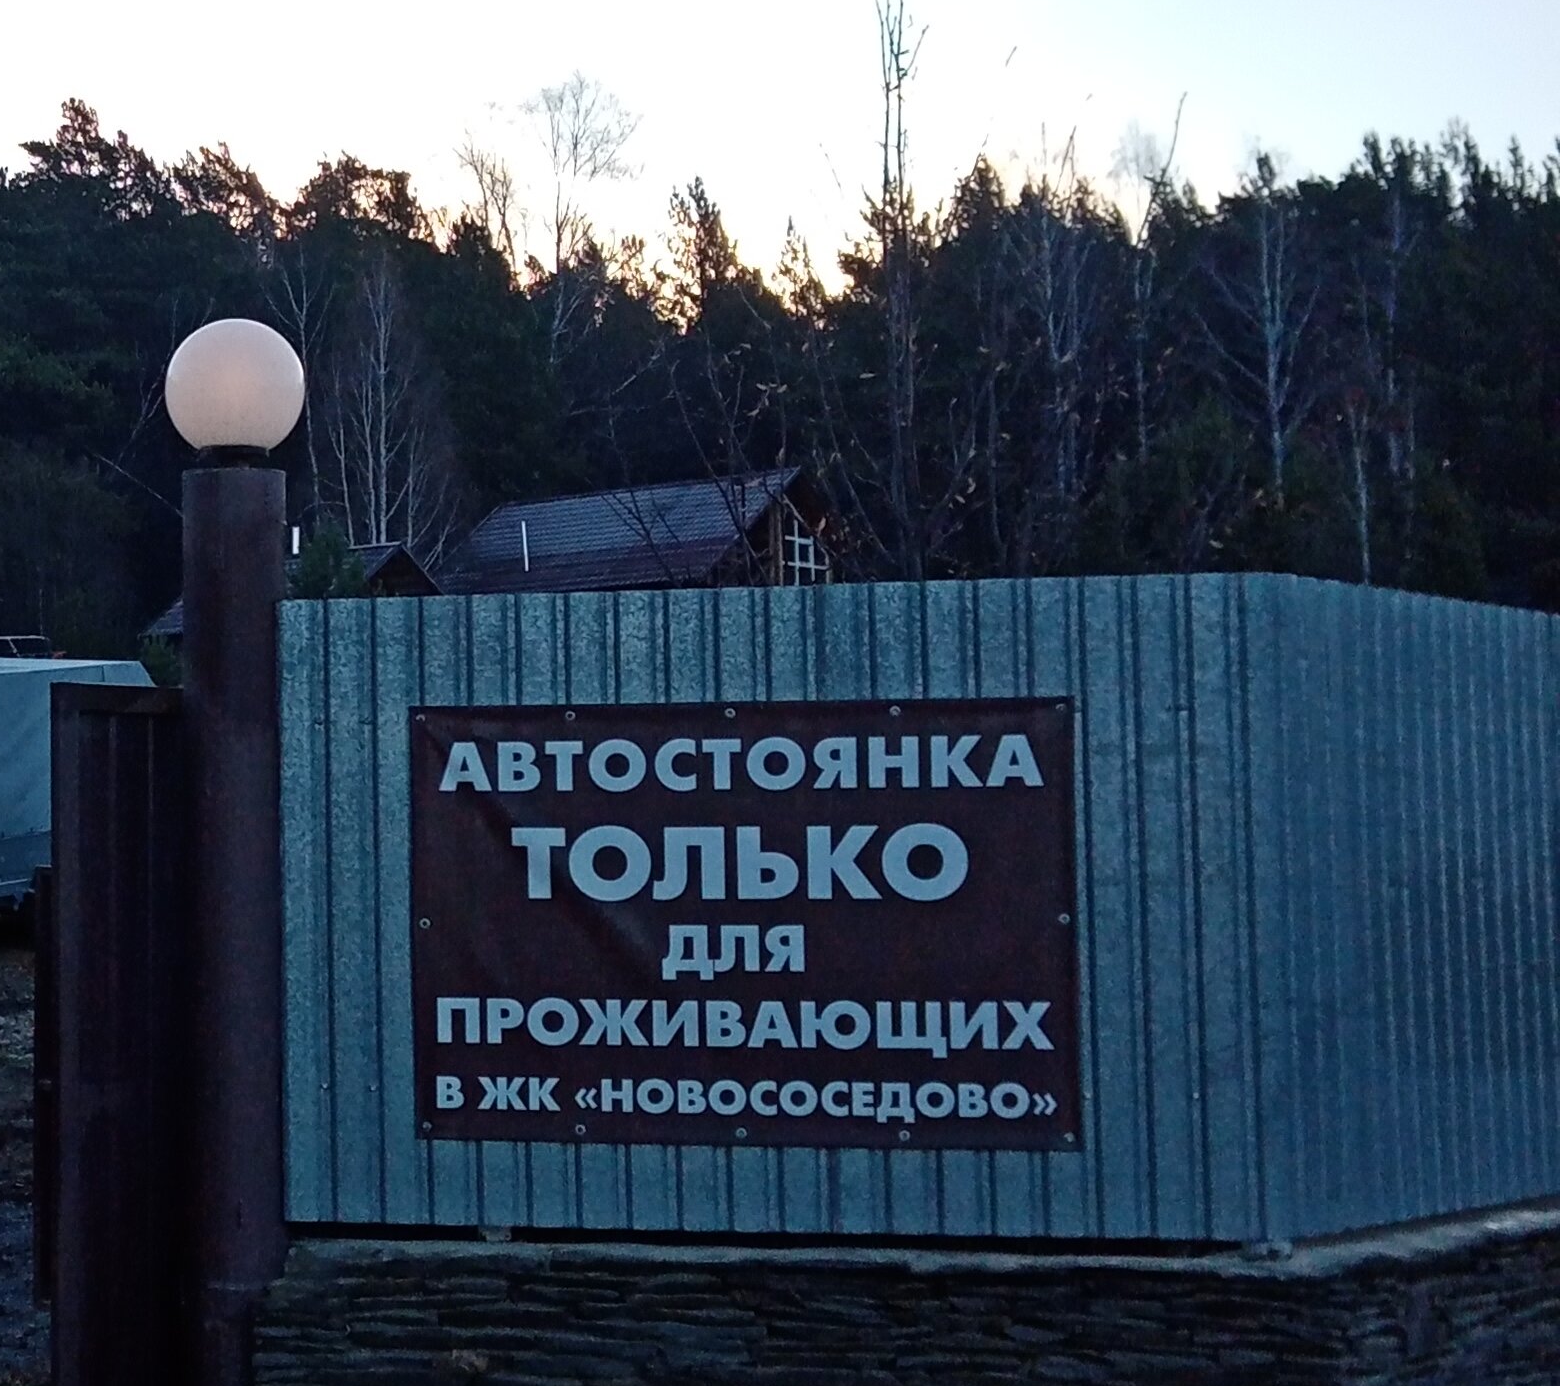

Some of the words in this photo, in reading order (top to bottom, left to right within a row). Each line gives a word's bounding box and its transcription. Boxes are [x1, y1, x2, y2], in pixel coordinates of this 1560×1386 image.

[438, 734, 1044, 792] АВТОСТОЯНКА
[511, 823, 969, 902] ТОЛЬКО
[661, 924, 806, 980] ДЛЯ
[436, 997, 1054, 1058] ПРОЖИВАЮЩИХ
[436, 1075, 464, 1109] В
[478, 1076, 560, 1111] ЖК
[574, 1077, 1057, 1123] «НОВОСОСЕДОВО»
